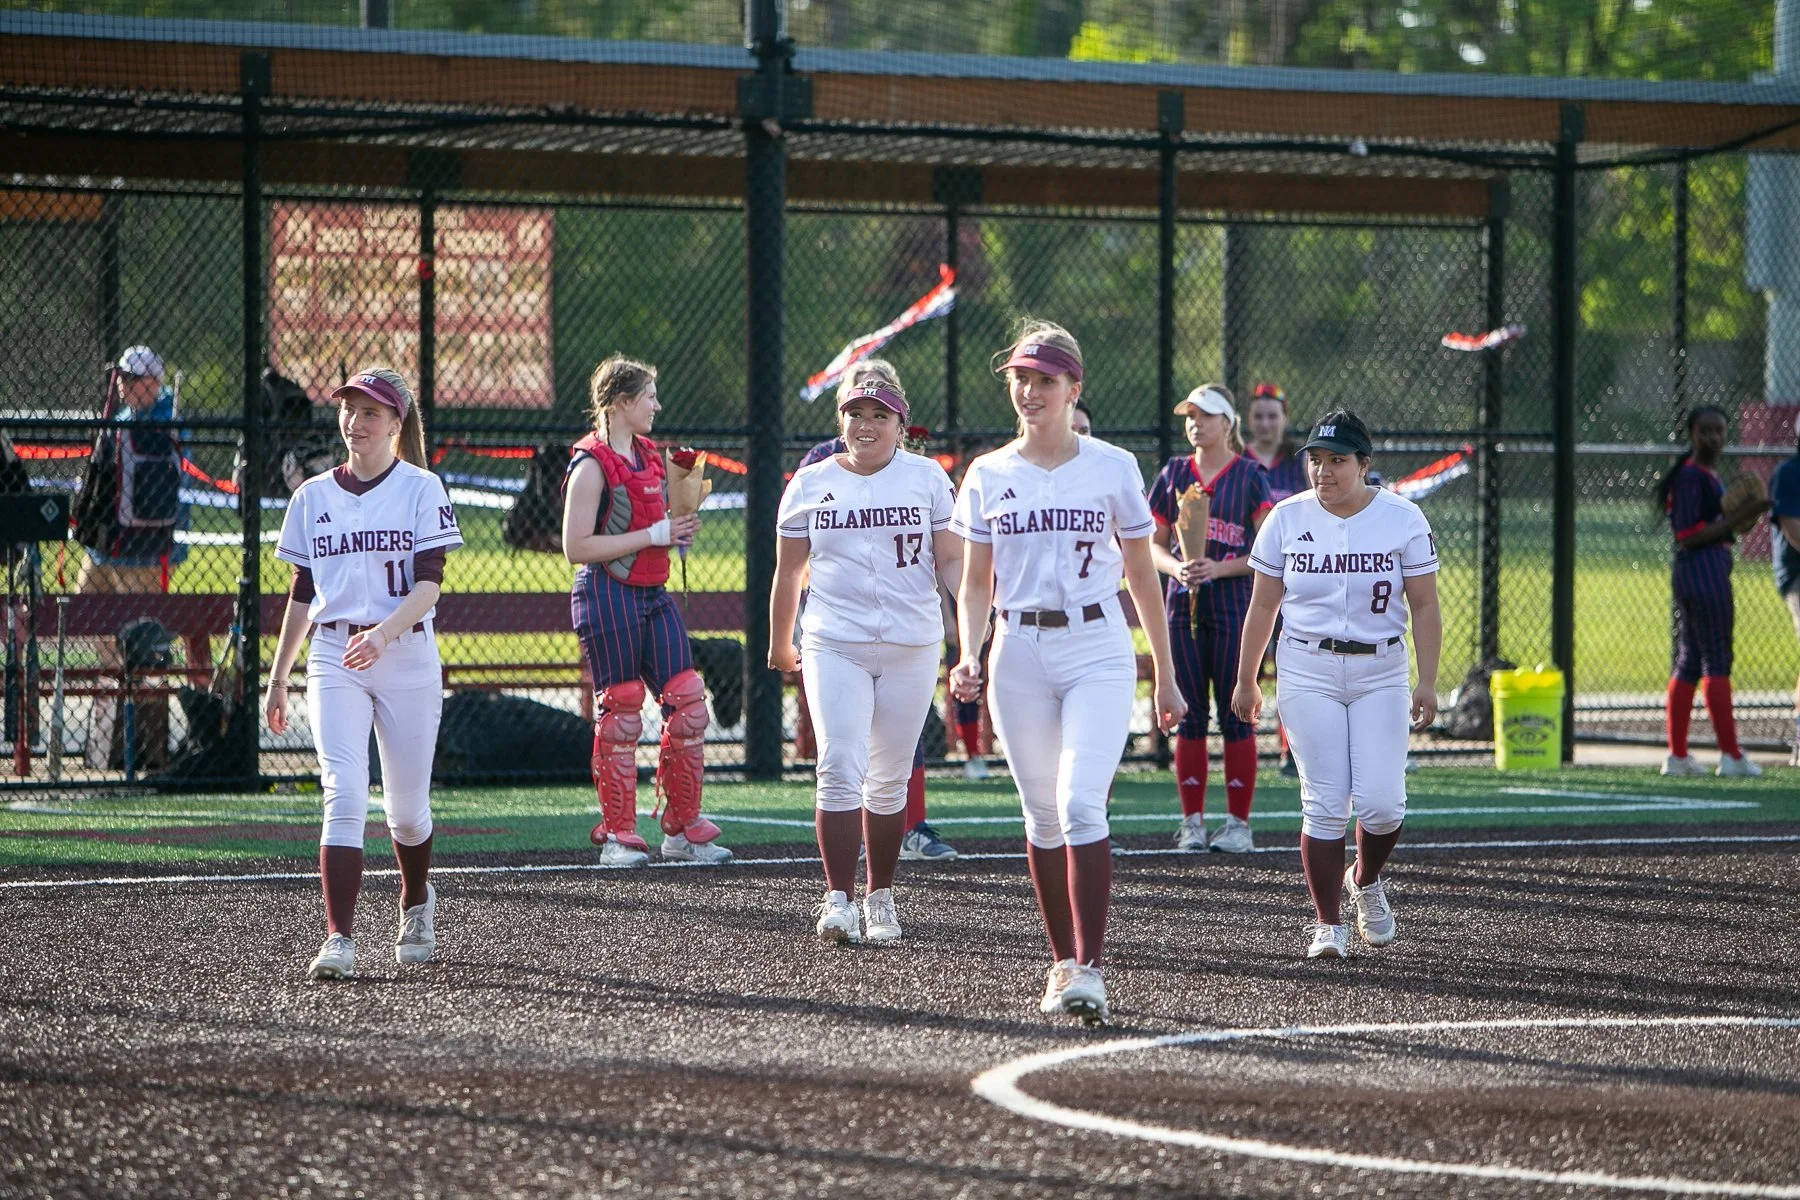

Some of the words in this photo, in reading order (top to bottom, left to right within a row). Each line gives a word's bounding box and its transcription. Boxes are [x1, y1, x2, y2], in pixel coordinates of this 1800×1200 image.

[815, 507, 922, 530] ISLANDERS
[313, 530, 413, 559] ISLANDERS
[894, 532, 924, 568] 17
[1075, 541, 1095, 579] 7
[384, 559, 411, 597] 11
[1291, 552, 1394, 574] ISLANDERS
[1371, 580, 1392, 614] 8
